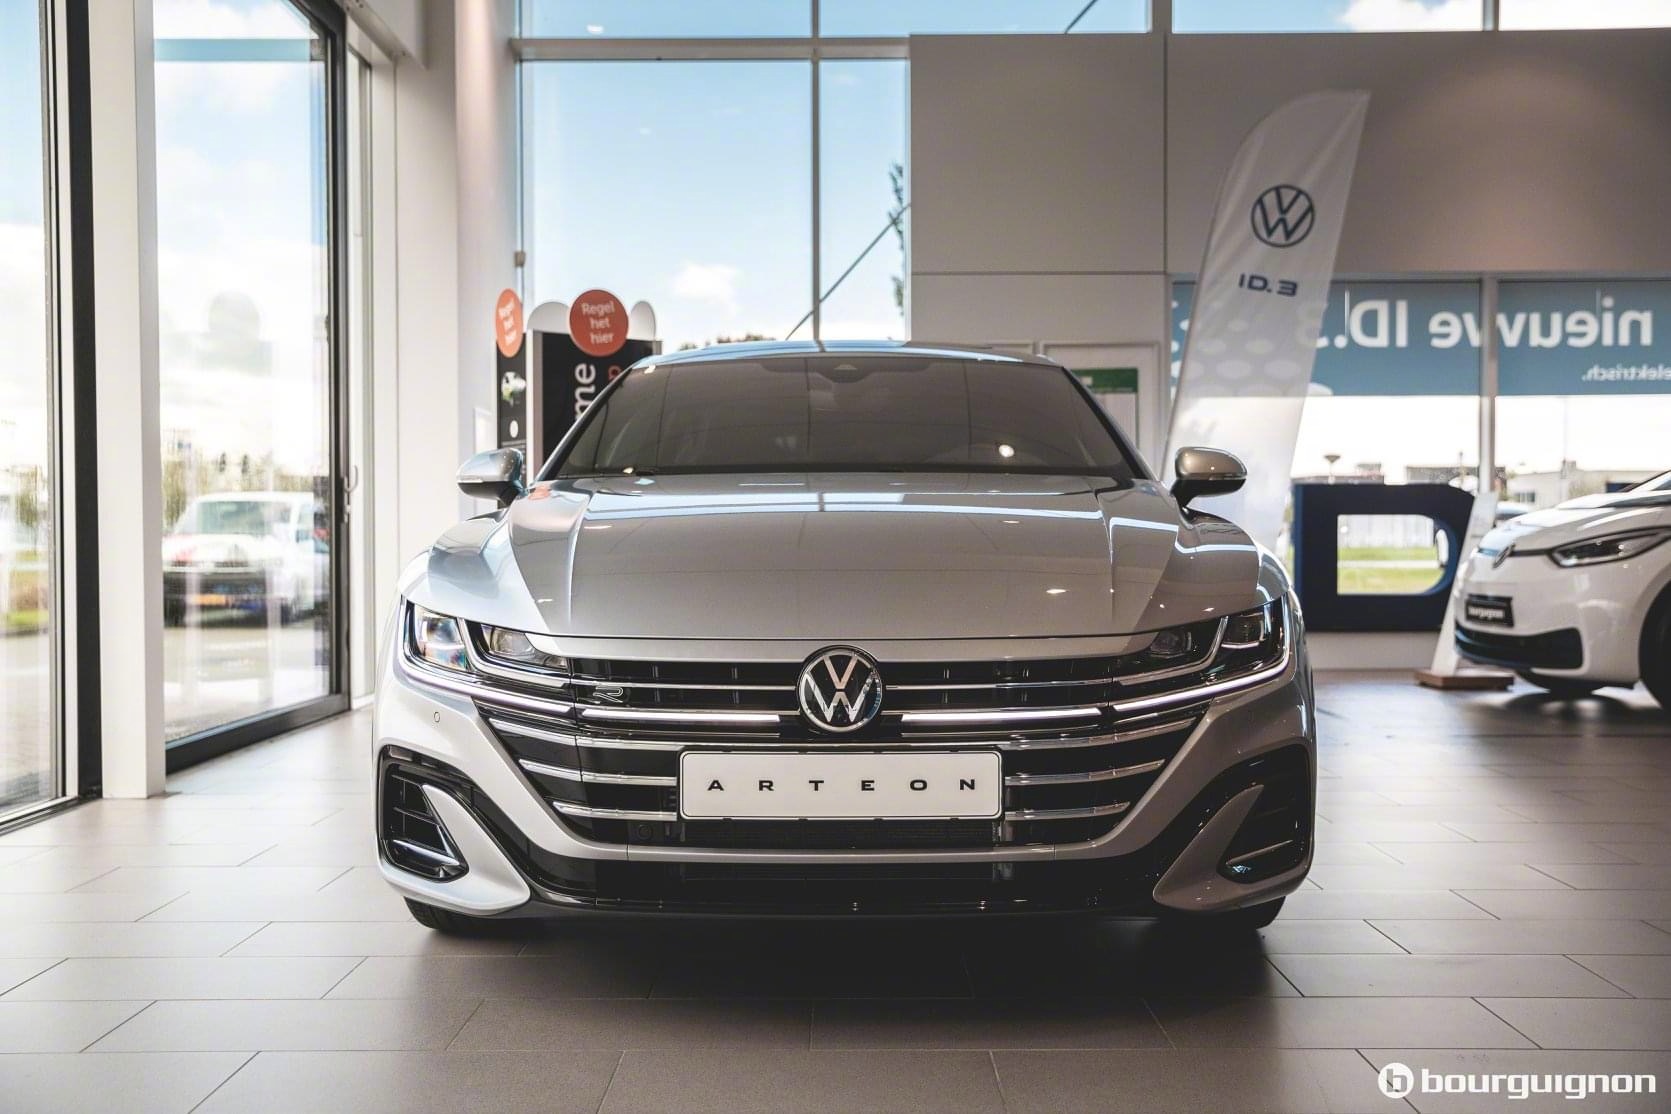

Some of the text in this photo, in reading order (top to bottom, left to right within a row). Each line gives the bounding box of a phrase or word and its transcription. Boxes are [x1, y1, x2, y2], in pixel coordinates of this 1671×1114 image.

[1238, 273, 1298, 297] ID.3
[590, 318, 610, 329] het
[707, 778, 977, 792] ARTEON
